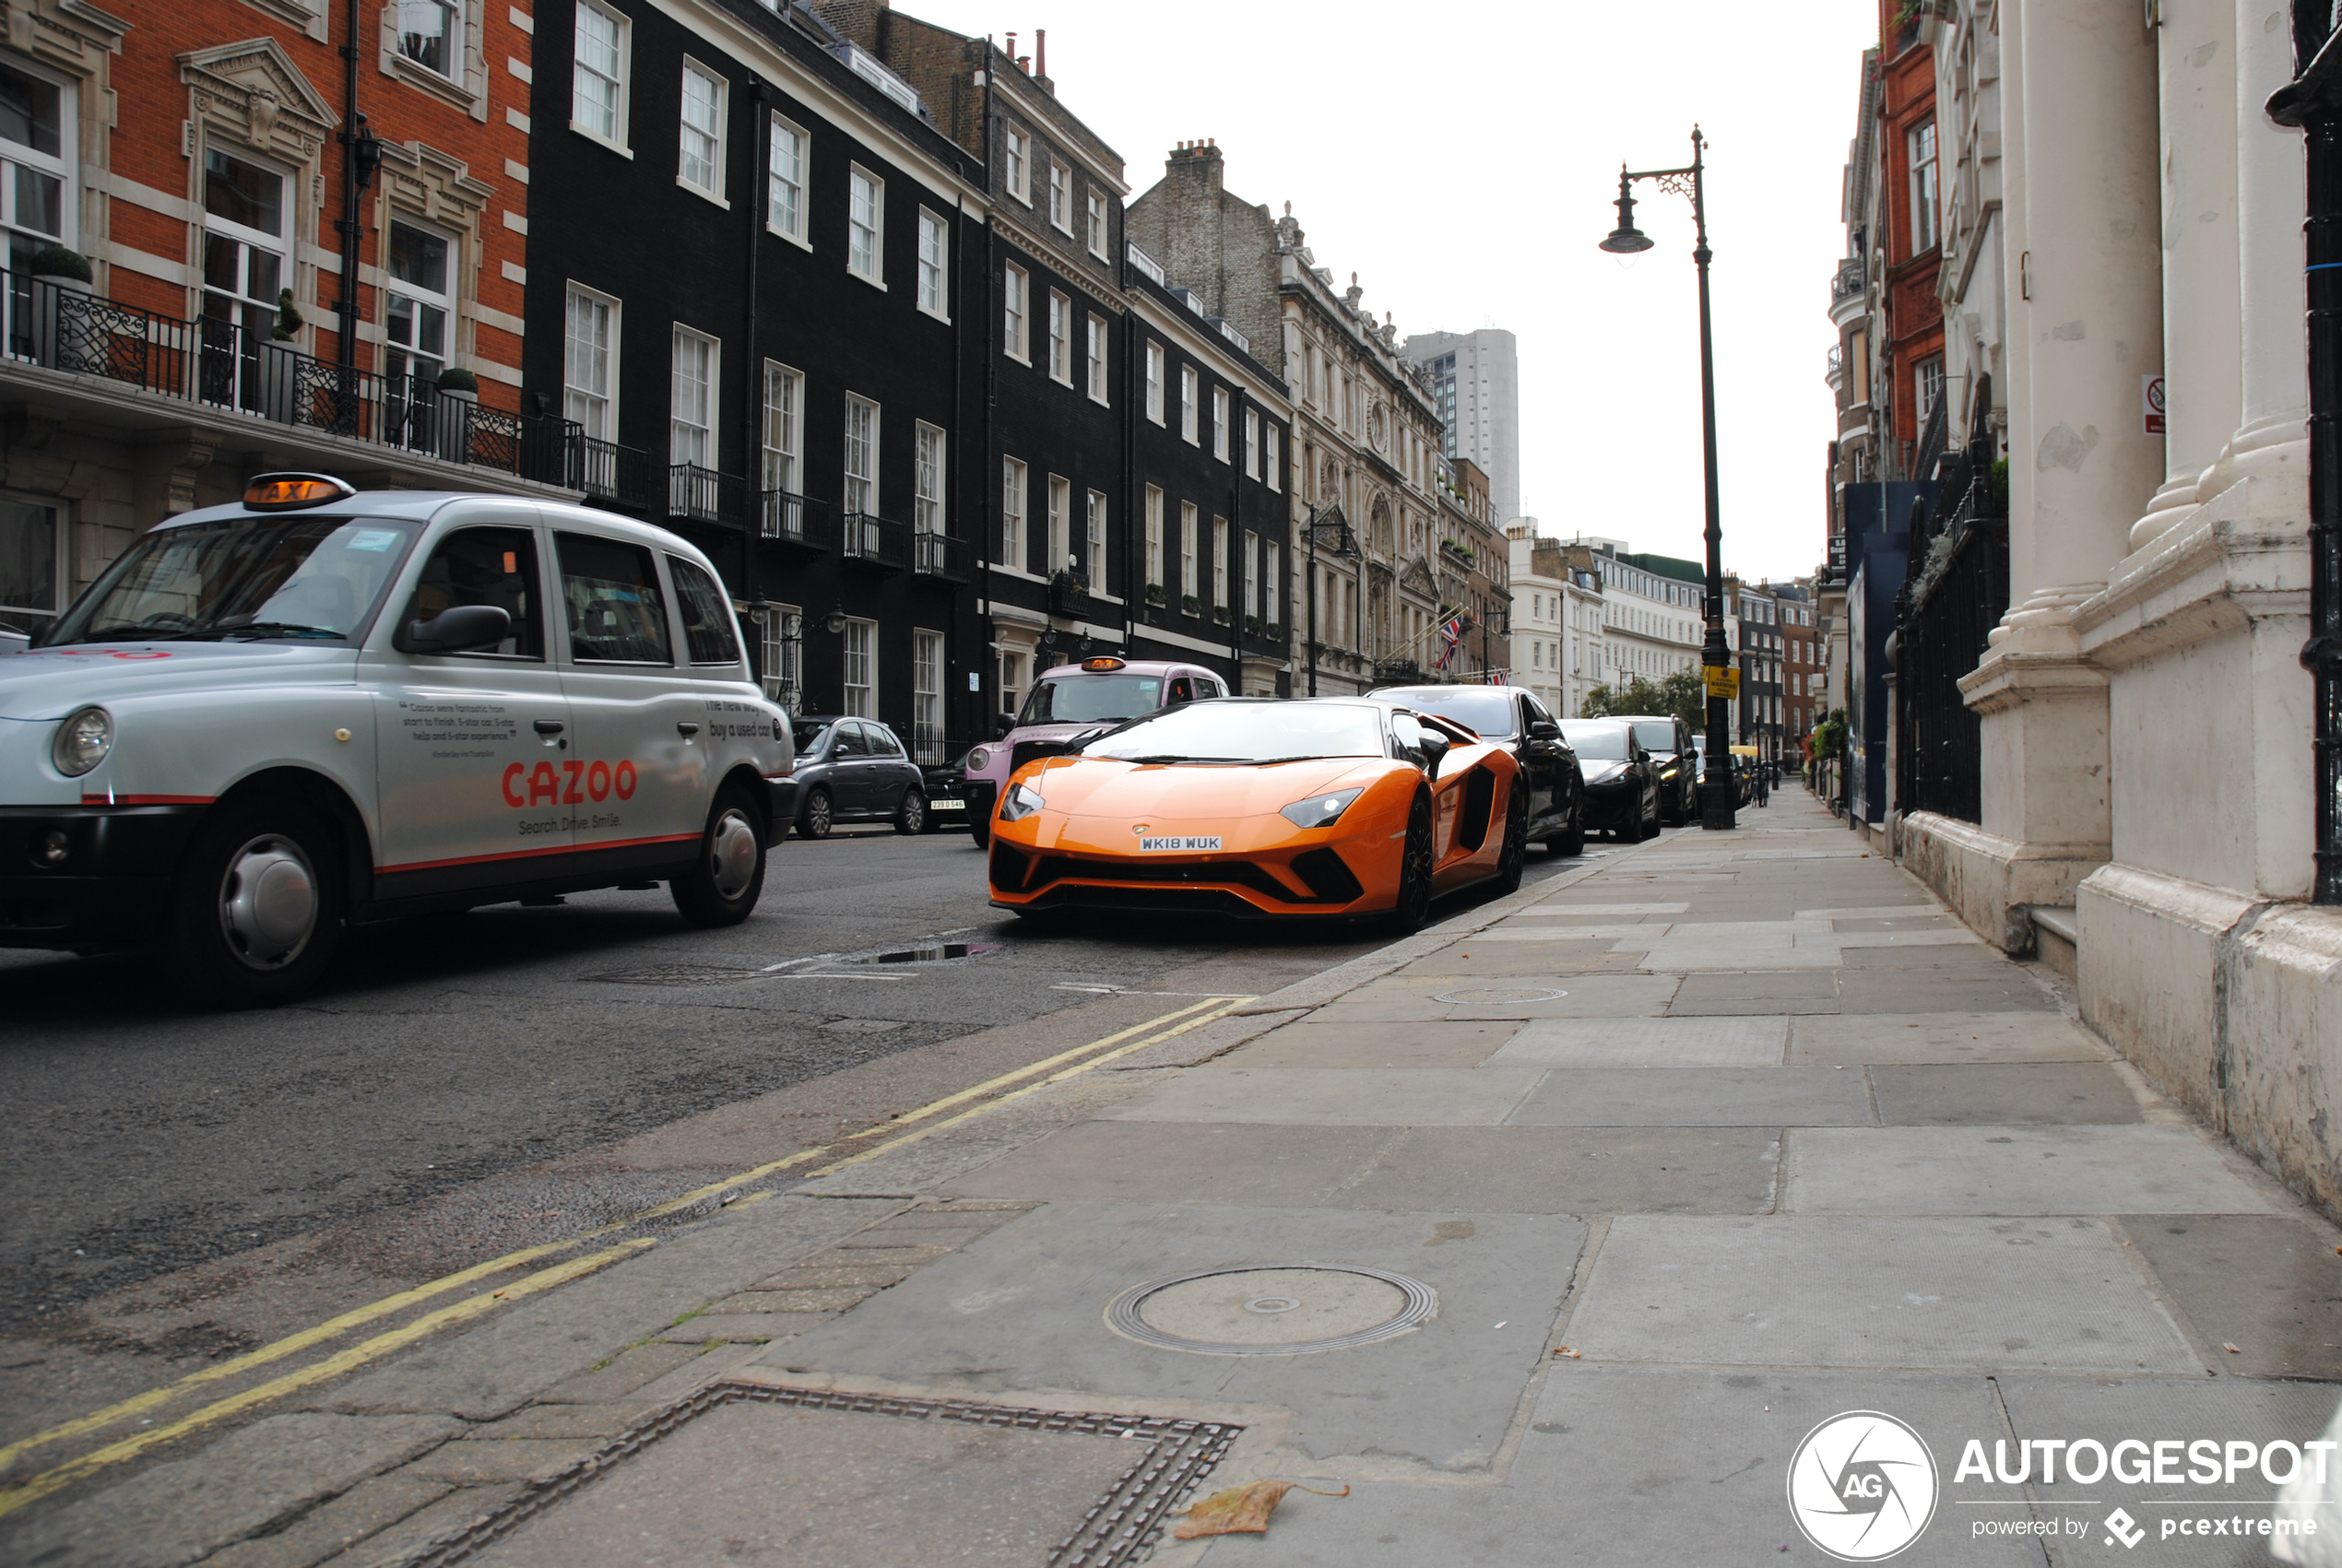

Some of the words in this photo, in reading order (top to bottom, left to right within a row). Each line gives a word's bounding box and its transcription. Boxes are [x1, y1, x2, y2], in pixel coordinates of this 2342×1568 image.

[258, 484, 313, 500] TAXI
[1711, 681, 1736, 690] WARNING
[455, 704, 488, 713] fantastic
[489, 704, 505, 713] from
[403, 718, 423, 726] start
[424, 718, 433, 726] to
[709, 720, 727, 741] buy
[728, 725, 736, 737] a
[737, 721, 756, 737] used
[758, 725, 771, 737] car
[413, 732, 431, 742] help
[432, 732, 446, 740] and
[448, 732, 469, 740] 5-star
[502, 759, 637, 808] CAZOO
[519, 818, 560, 835] Search.
[562, 815, 591, 831] Drive.
[592, 813, 621, 829] Smile.
[1142, 838, 1180, 849] WK18
[1186, 837, 1219, 849] WUK
